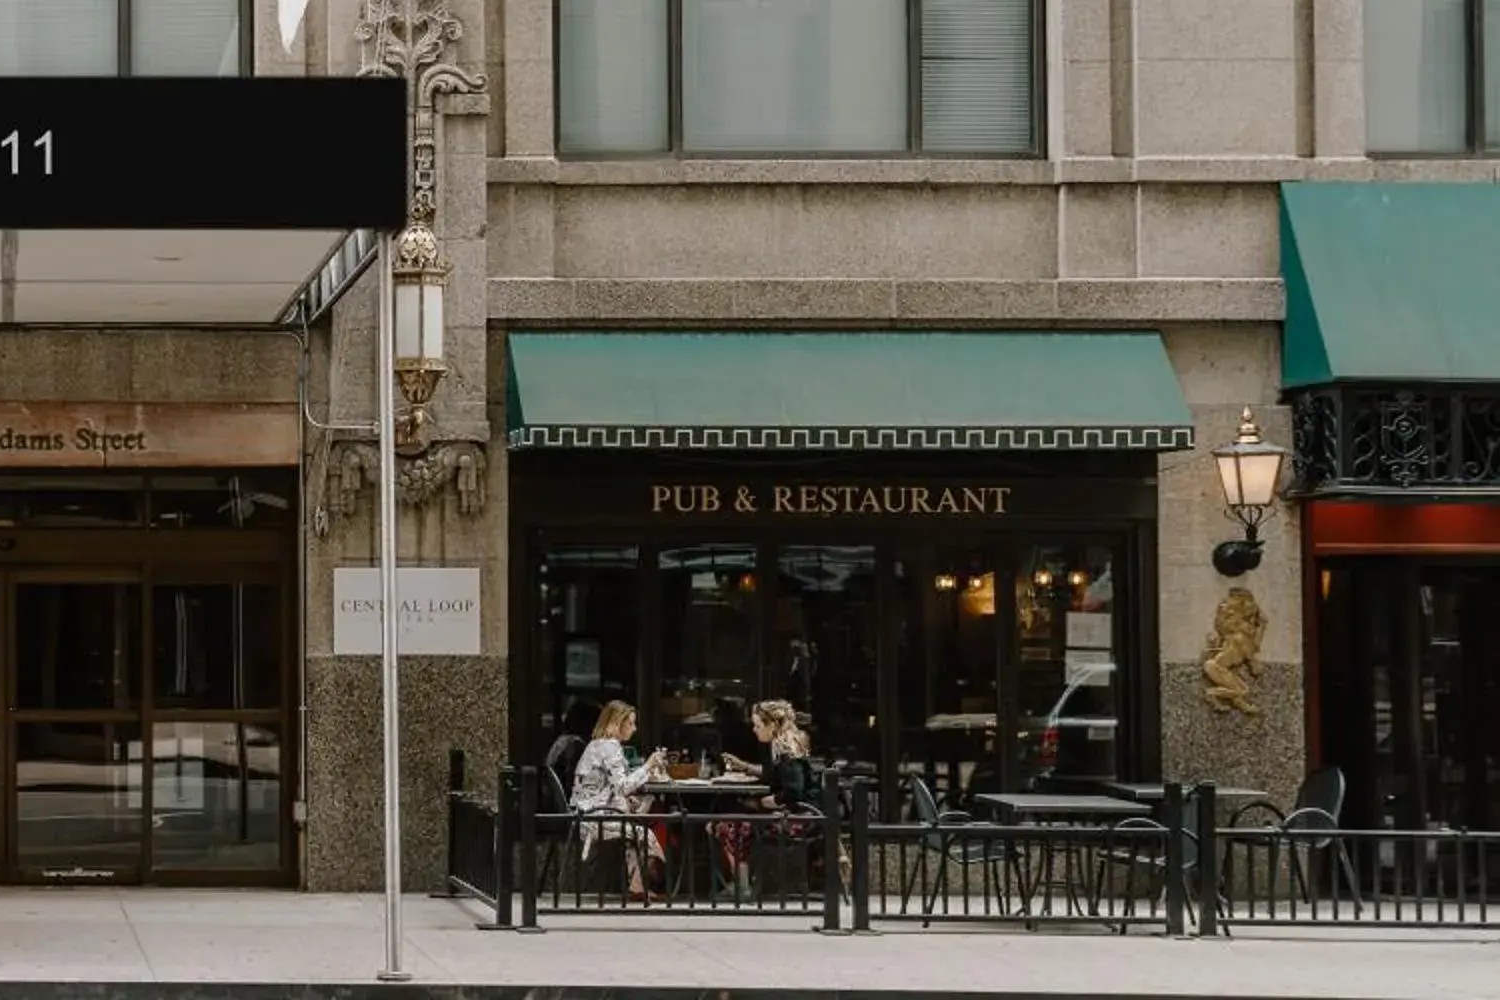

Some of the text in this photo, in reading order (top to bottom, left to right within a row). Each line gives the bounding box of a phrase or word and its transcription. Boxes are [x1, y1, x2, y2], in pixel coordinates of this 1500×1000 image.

[75, 427, 146, 450] Street
[652, 486, 1011, 513] PUB & RESTAURANT
[340, 599, 475, 613] CENTAL LOOP
